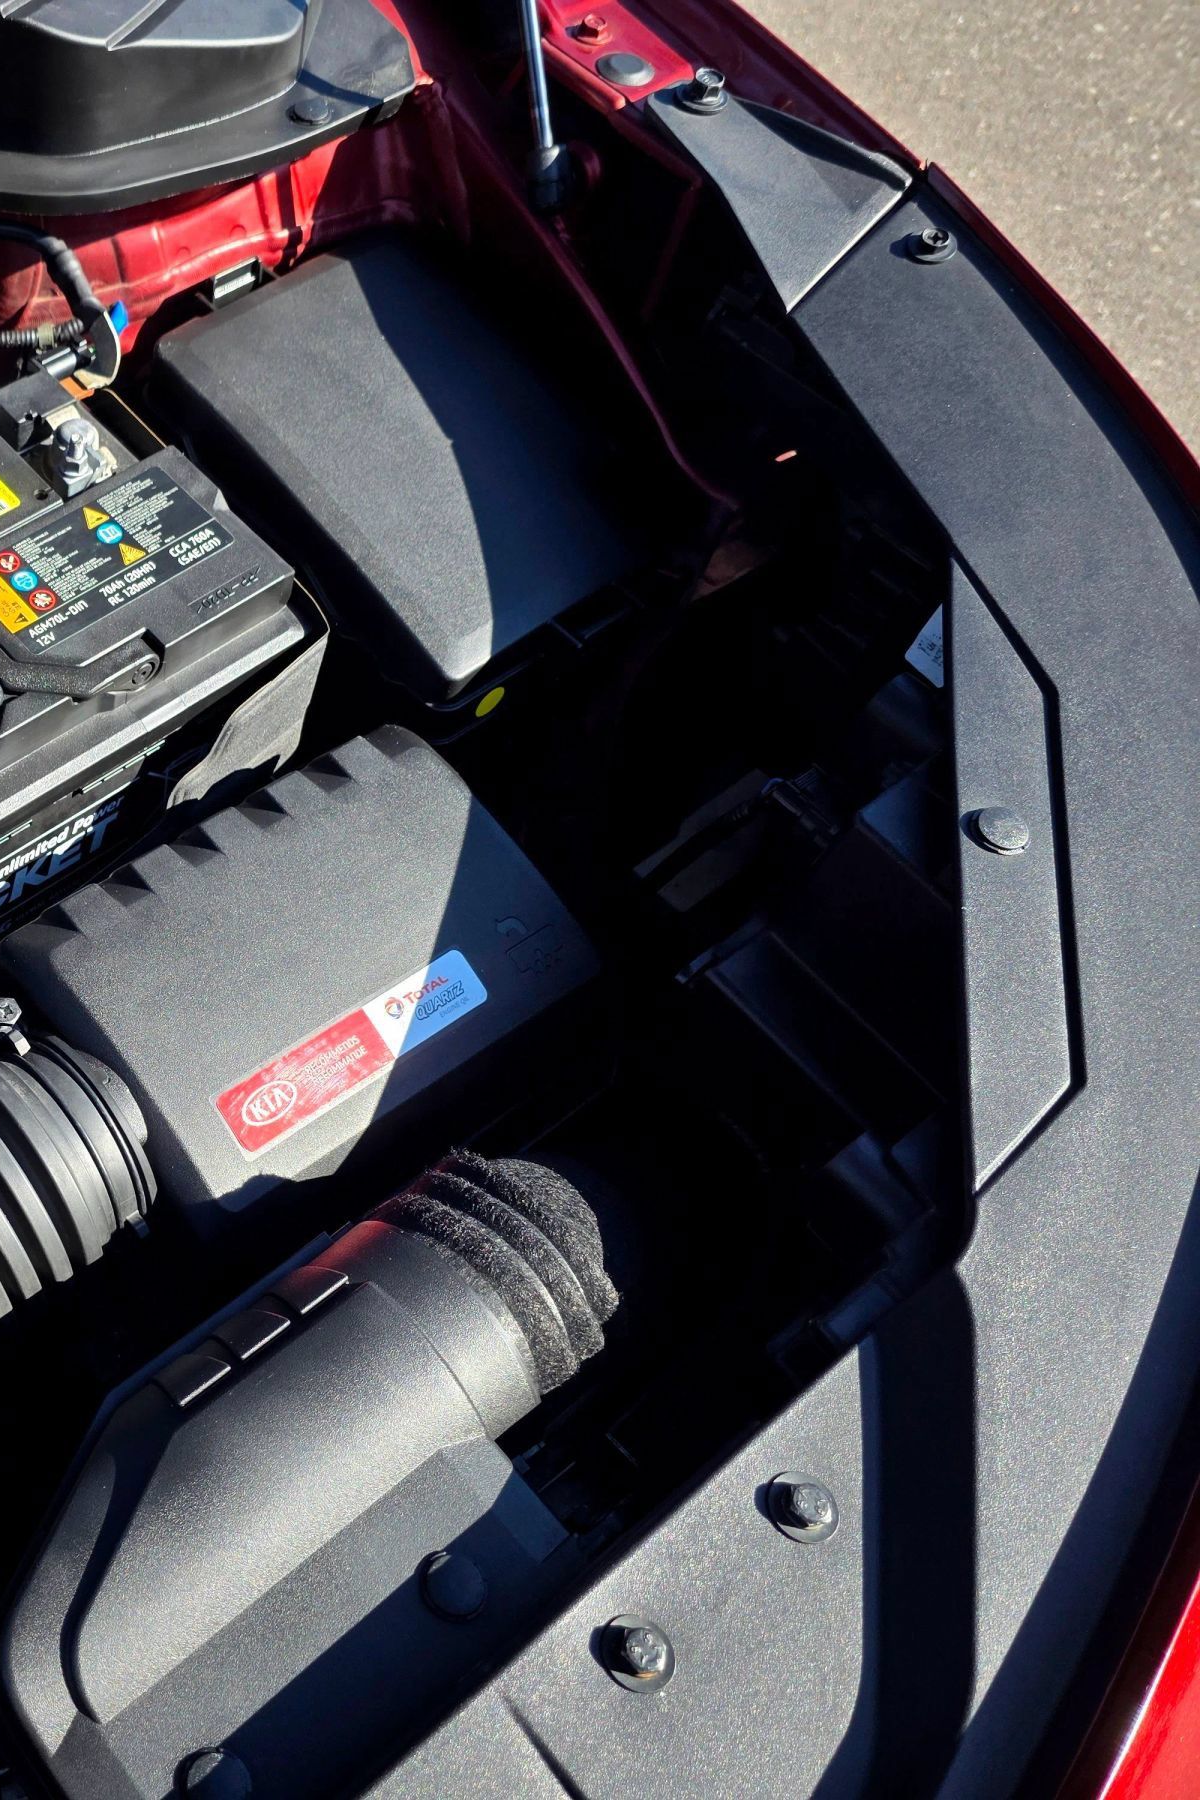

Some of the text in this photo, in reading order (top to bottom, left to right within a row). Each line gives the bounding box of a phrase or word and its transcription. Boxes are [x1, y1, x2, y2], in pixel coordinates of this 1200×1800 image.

[168, 528, 215, 558] CCA 760A
[99, 561, 157, 597] 70Ah (20HR)
[108, 575, 157, 607] RC 120min
[28, 600, 89, 639] AGM70L-DIN
[36, 631, 56, 647] 12V
[71, 796, 125, 834] Power
[402, 976, 449, 1004] TOTAL
[415, 980, 464, 1021] QUARTZ
[304, 1034, 361, 1076] RECOMMENDS
[249, 1086, 291, 1121] KIA
